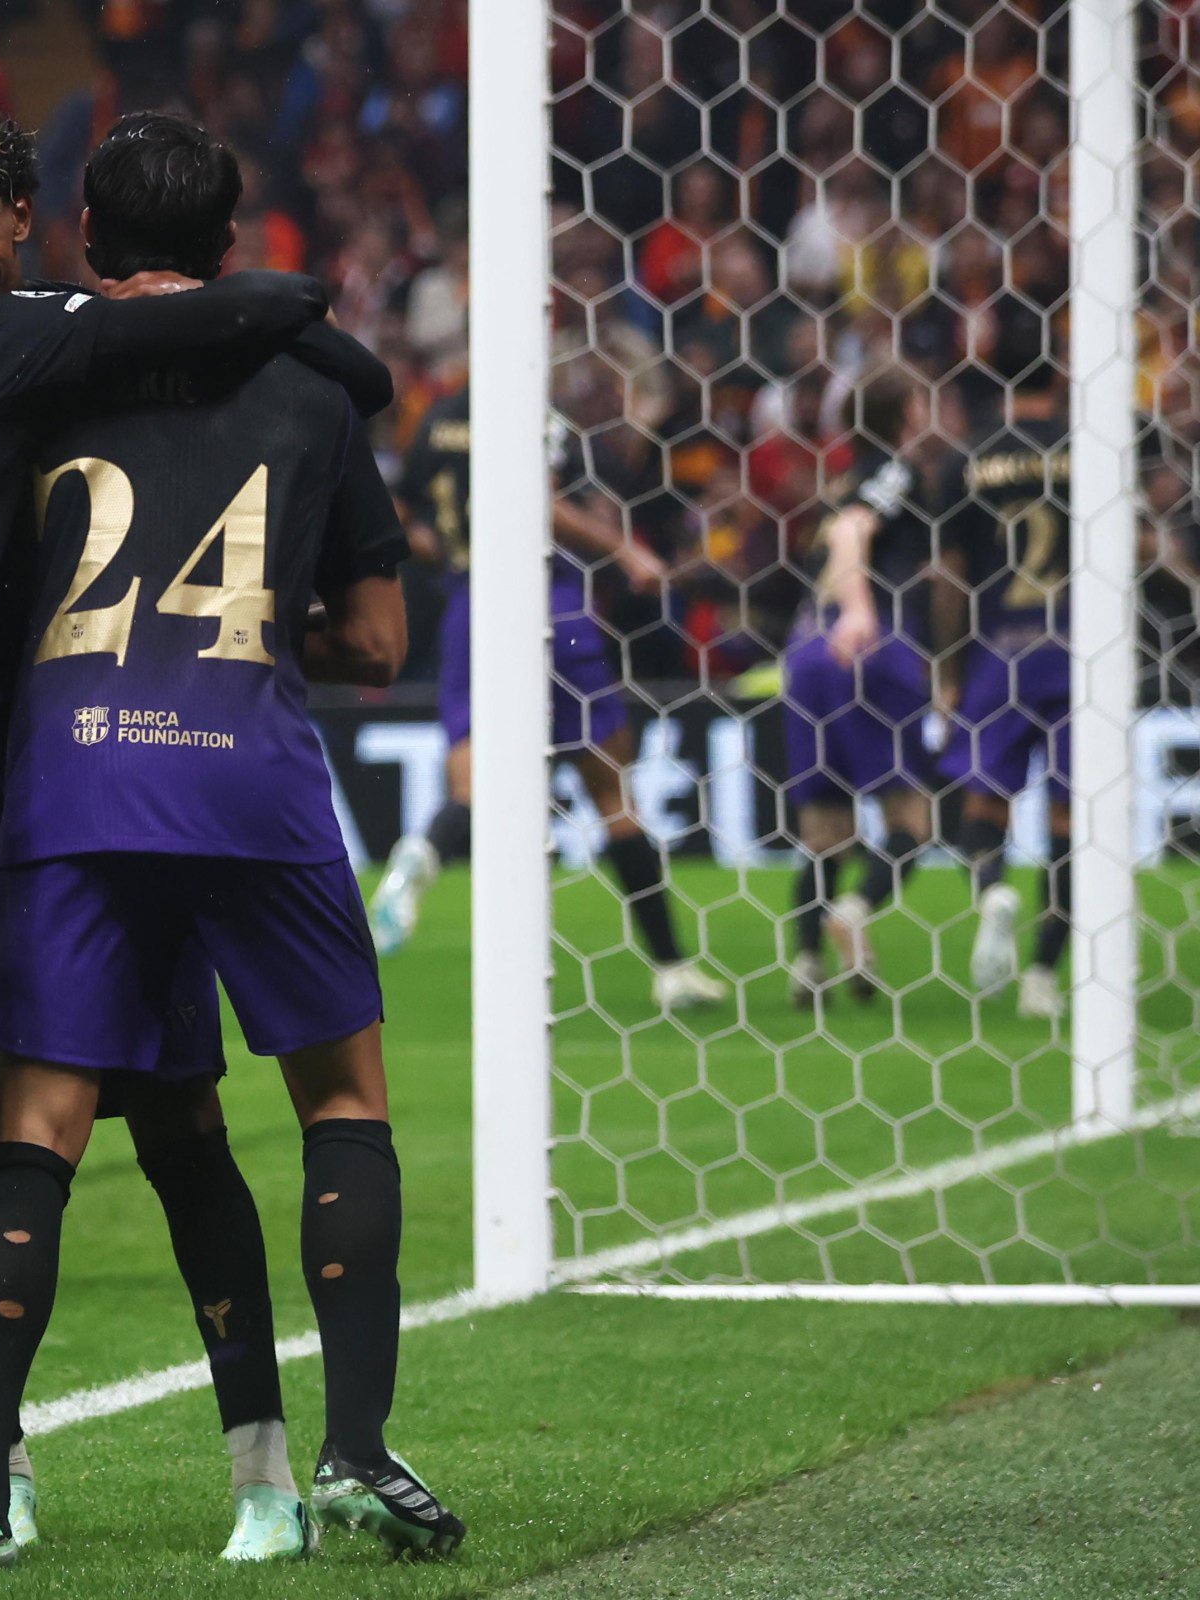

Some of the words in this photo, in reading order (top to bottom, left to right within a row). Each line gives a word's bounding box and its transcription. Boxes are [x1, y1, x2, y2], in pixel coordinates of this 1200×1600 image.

[33, 456, 276, 667] 24
[118, 709, 179, 729] BARÇA
[117, 727, 234, 749] FOUNDATION
